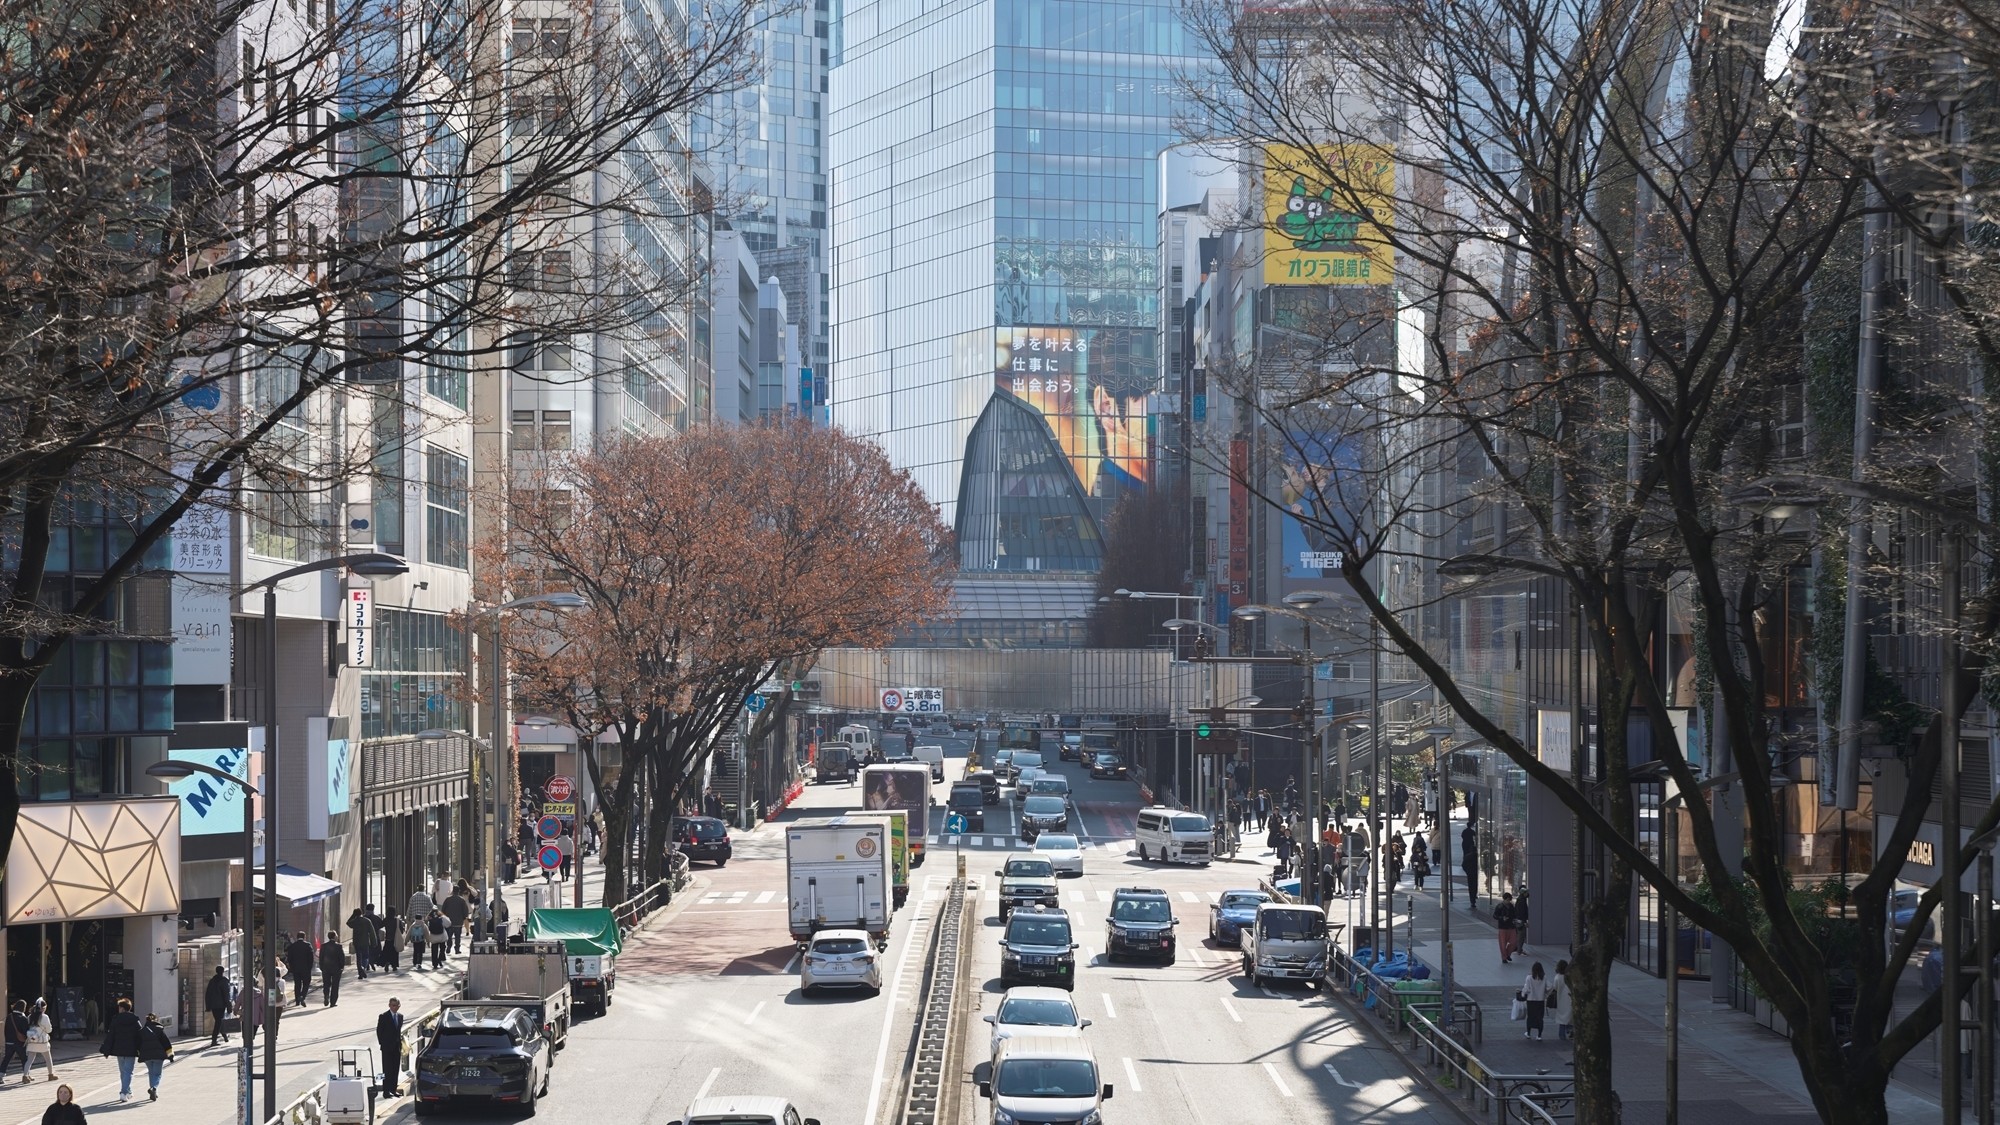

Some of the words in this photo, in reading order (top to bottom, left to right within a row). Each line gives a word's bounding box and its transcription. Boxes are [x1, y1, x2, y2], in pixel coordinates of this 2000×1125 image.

[1012, 335, 1088, 352] 夢を叶える
[1012, 356, 1059, 372] 仕事に
[1012, 377, 1080, 394] 出会おう。
[176, 524, 222, 541] お茶の水
[180, 543, 222, 557] 美容形成
[179, 556, 223, 570] クリニック
[1300, 558, 1343, 569] TIGER
[183, 622, 220, 636] vain
[356, 603, 364, 666] ココカラファイン
[904, 690, 942, 700] 上限高さ
[905, 700, 941, 712] 3.8m
